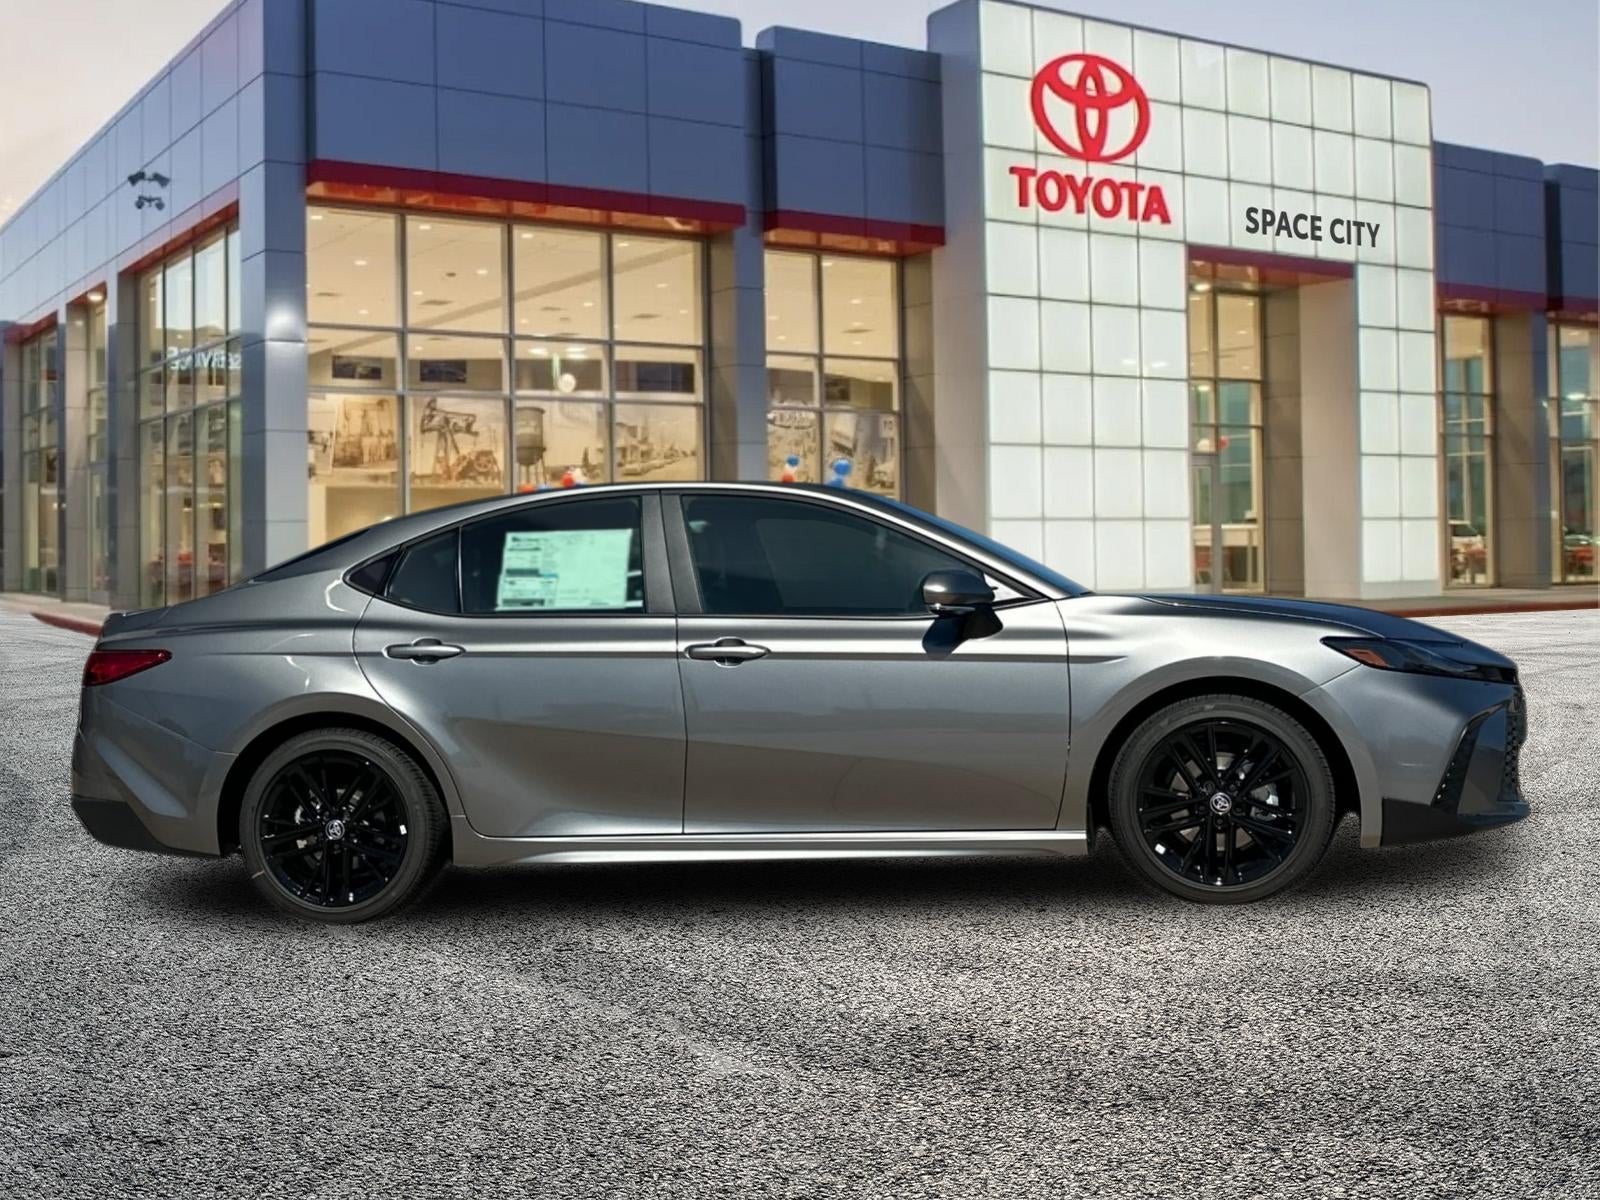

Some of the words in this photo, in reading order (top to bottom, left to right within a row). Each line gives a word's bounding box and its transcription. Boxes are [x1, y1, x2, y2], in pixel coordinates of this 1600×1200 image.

[1009, 166, 1171, 225] TOYOTA
[1245, 206, 1323, 241] SPACE
[1329, 218, 1381, 247] CITY
